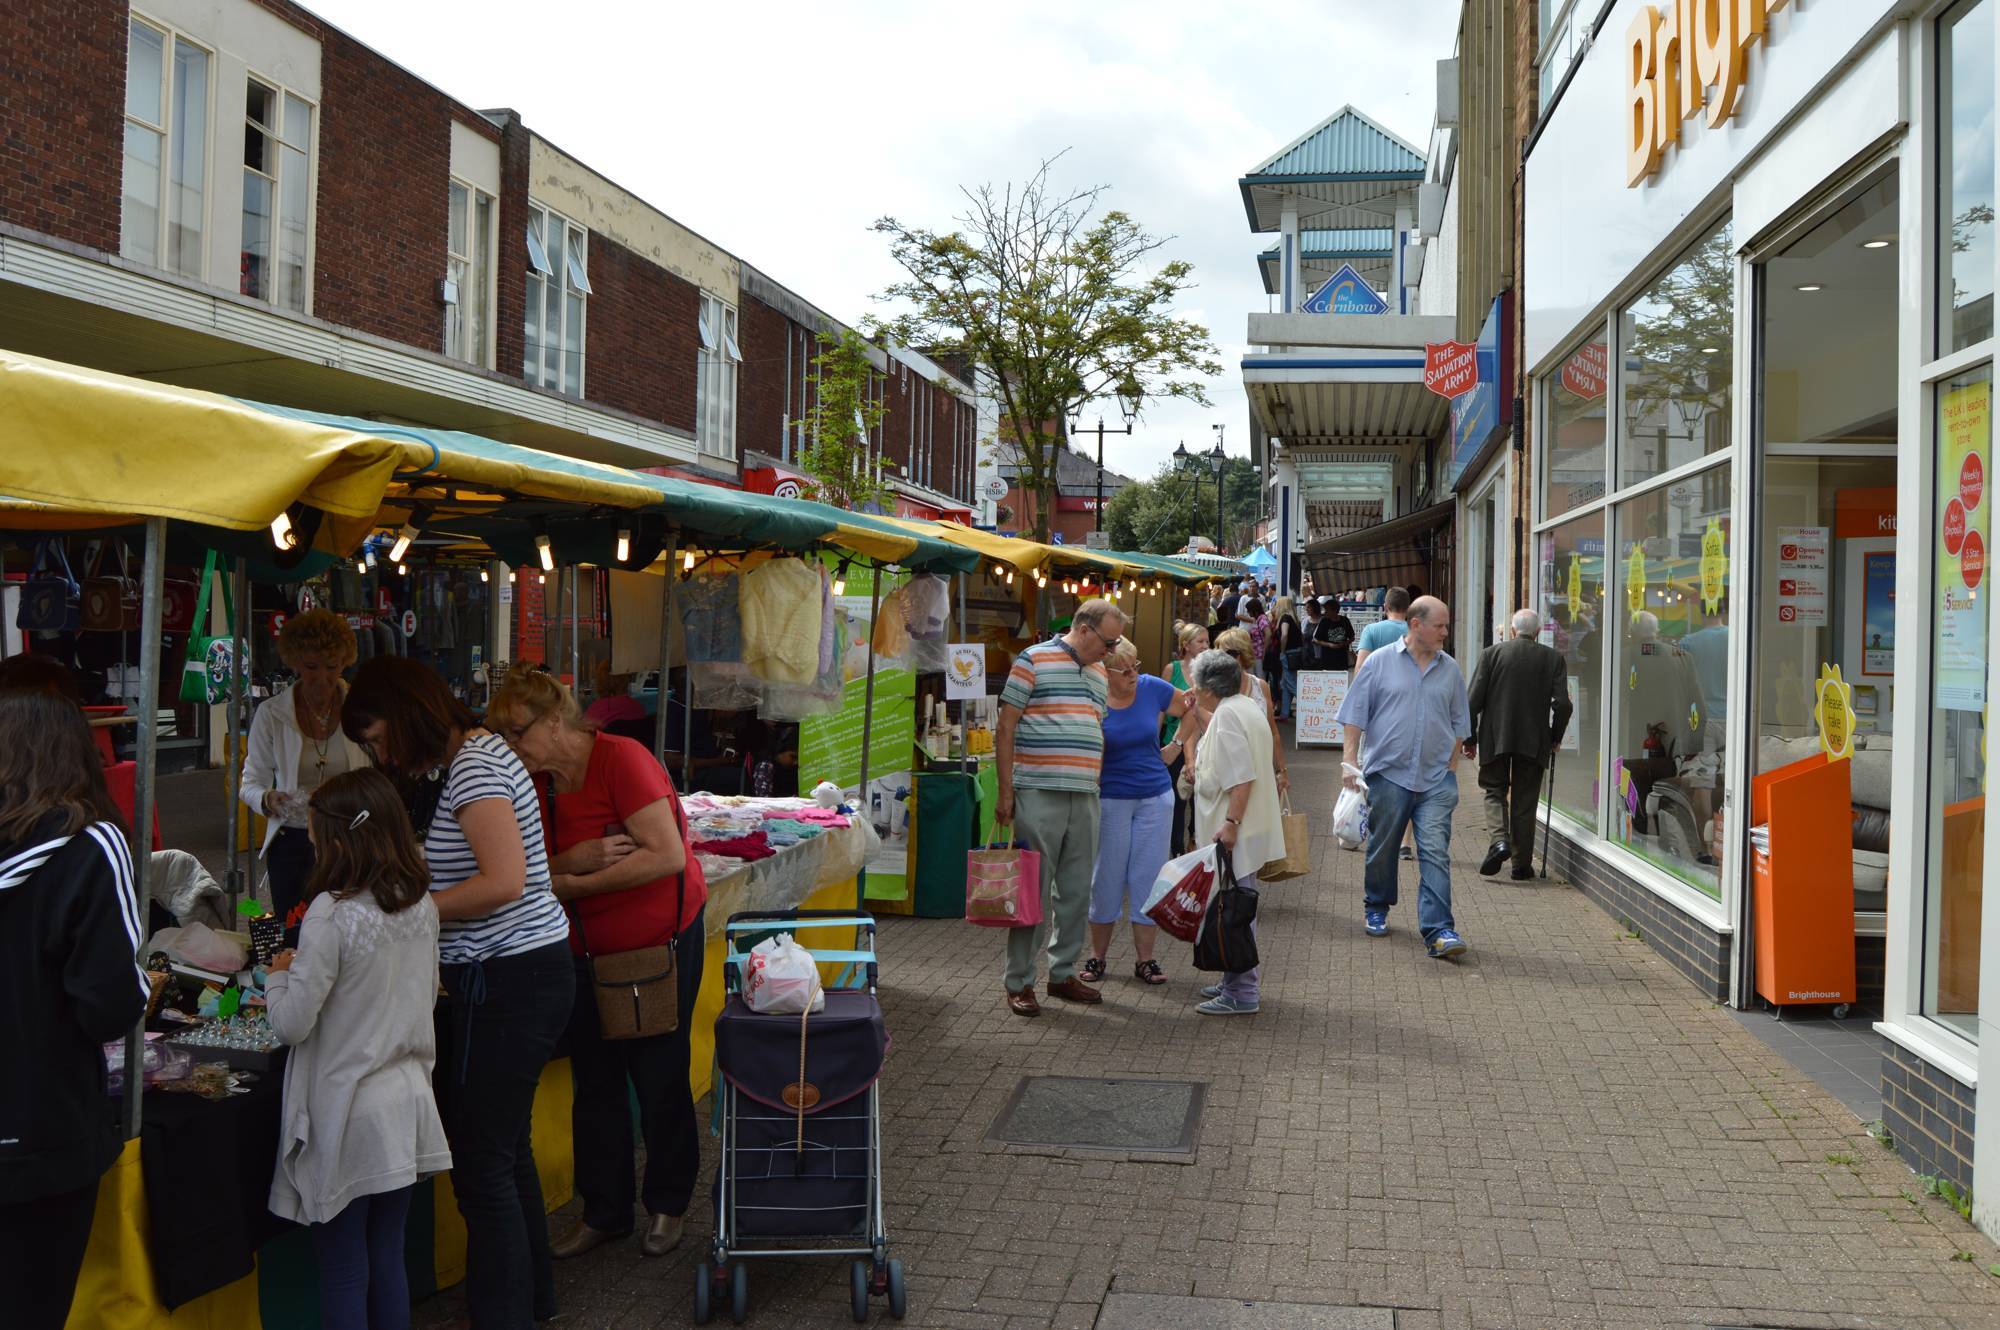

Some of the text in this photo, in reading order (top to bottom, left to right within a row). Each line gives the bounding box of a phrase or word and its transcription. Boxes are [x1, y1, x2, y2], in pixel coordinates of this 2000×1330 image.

[1315, 301, 1377, 313] Cornbow
[1434, 345, 1455, 364] THE
[1426, 349, 1473, 385] SALVATION
[1443, 366, 1472, 392] ARMY
[1963, 470, 1980, 481] Weekly
[1961, 482, 1982, 496] Payments
[1950, 513, 1957, 523] No
[1964, 561, 1981, 570] Service
[379, 589, 388, 610] L
[1951, 599, 1974, 610] SERVICE
[405, 615, 413, 632] E
[1824, 694, 1842, 710] Please
[1830, 734, 1842, 746] one
[1788, 990, 1841, 1000] Brighthouse
